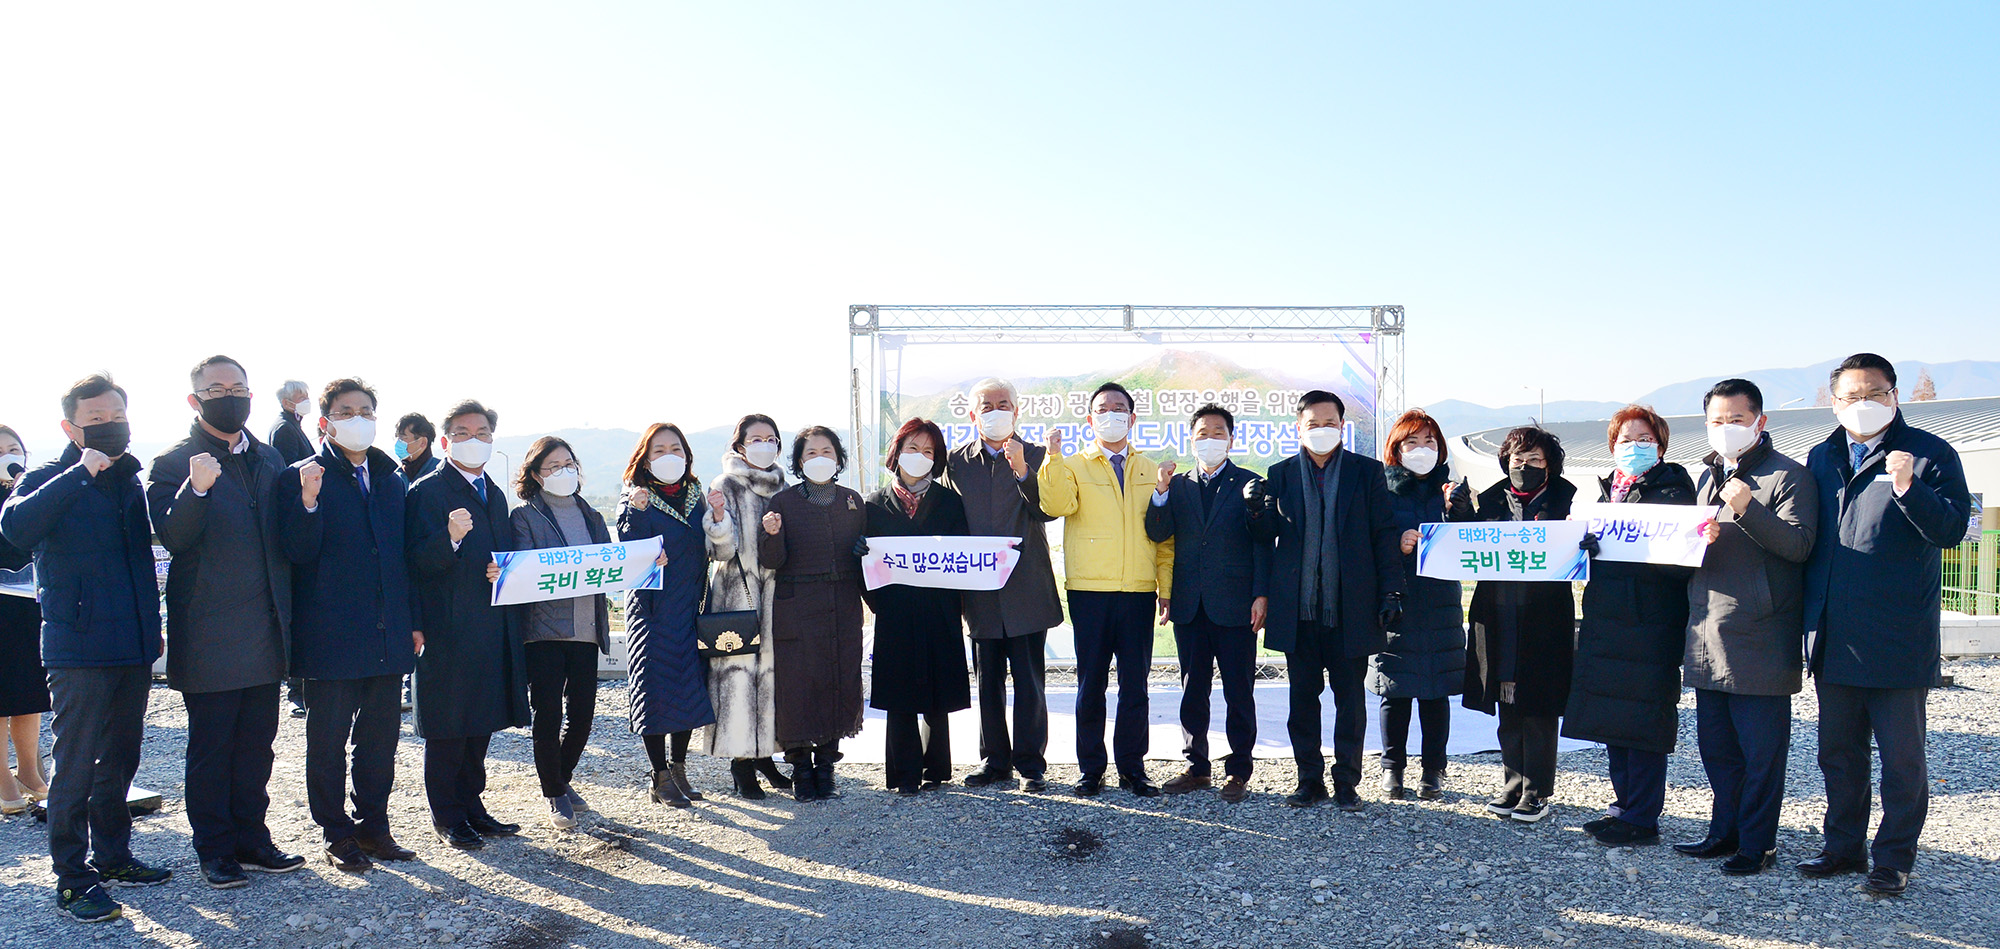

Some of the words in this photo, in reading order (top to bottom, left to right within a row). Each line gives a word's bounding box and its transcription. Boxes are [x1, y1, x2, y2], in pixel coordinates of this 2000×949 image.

[1458, 527, 1501, 544] 태화강
[1517, 526, 1547, 544] 송정
[1592, 518, 1680, 543] 감사합니다
[538, 549, 584, 566] 태화강
[600, 545, 627, 562] 송정
[883, 552, 908, 569] 수고
[912, 551, 998, 574] 많으셨습니다
[1460, 550, 1501, 574] 국비
[1507, 549, 1547, 574] 확보
[537, 570, 579, 594] 국비
[584, 566, 624, 588] 확보
